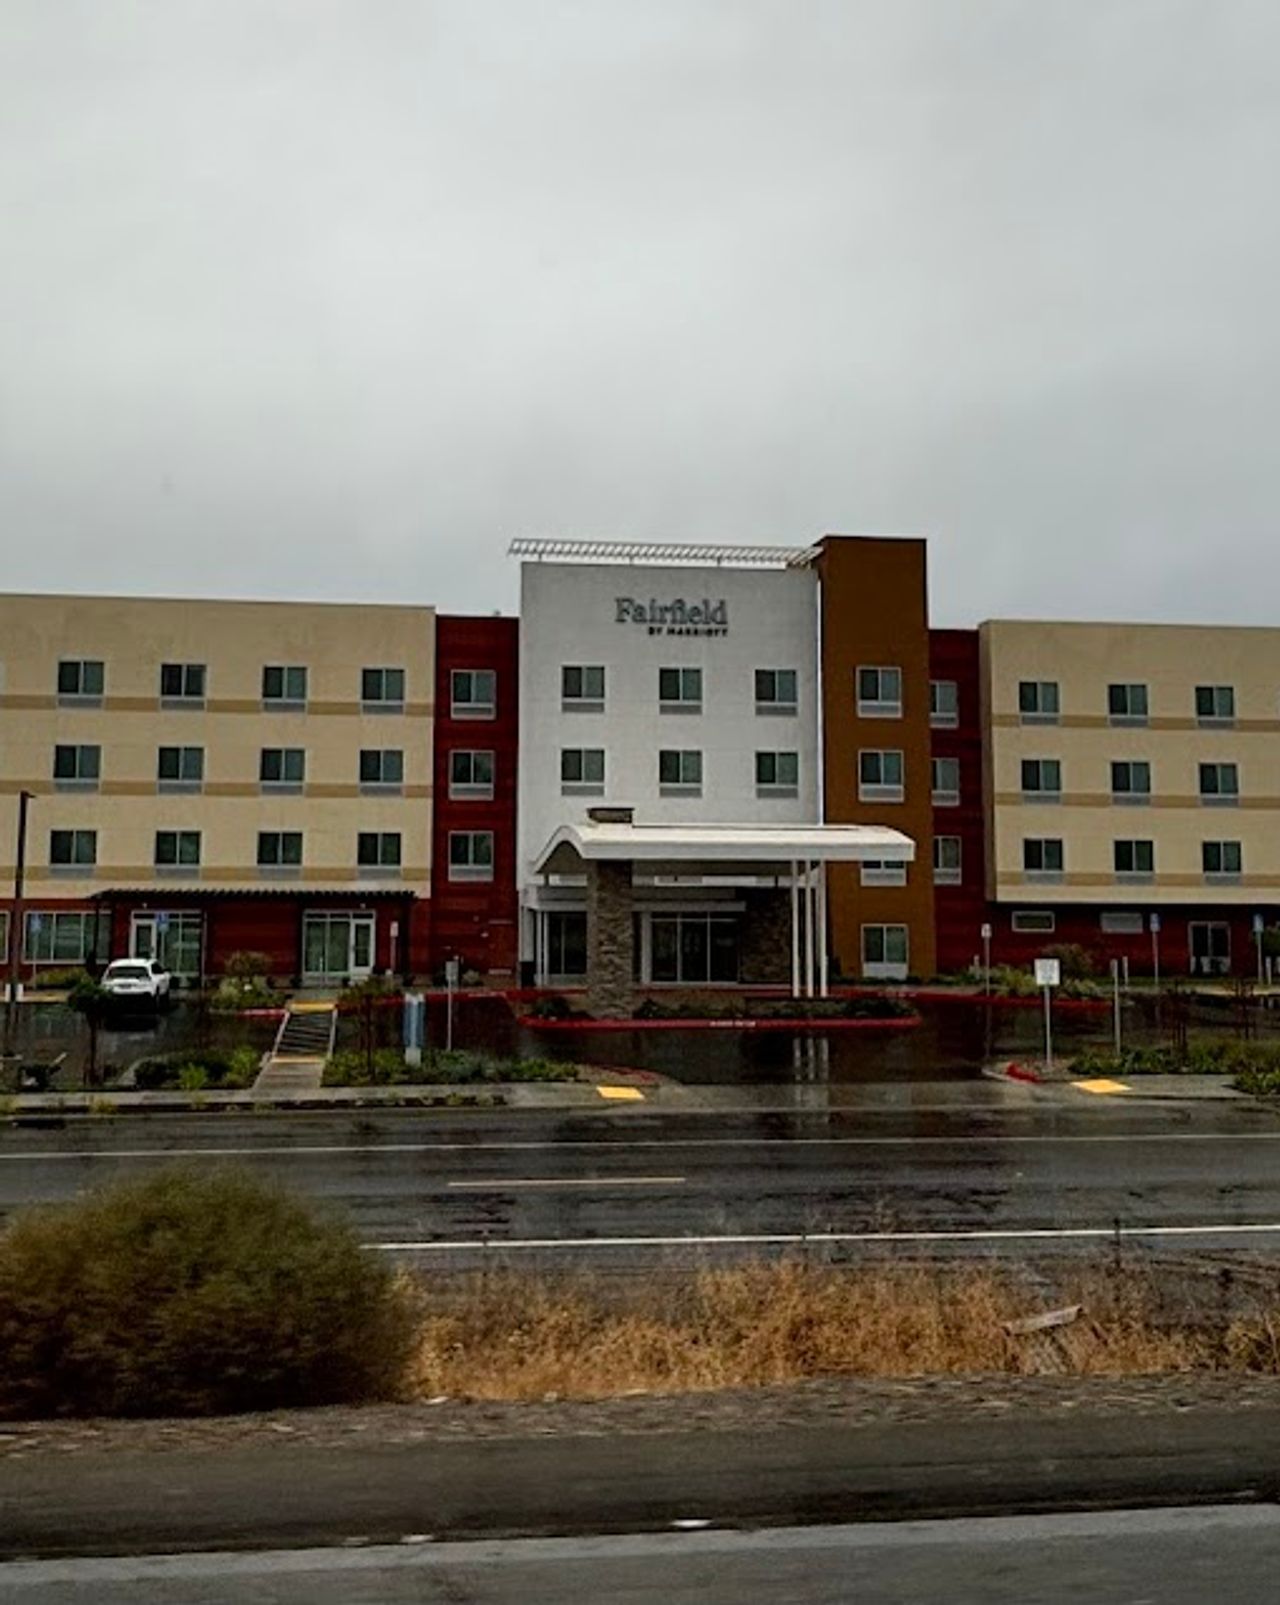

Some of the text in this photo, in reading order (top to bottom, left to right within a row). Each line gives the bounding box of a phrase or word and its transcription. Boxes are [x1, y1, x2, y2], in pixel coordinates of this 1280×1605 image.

[614, 597, 727, 624] Fairfield
[648, 627, 728, 636] BY MARRIOTT
